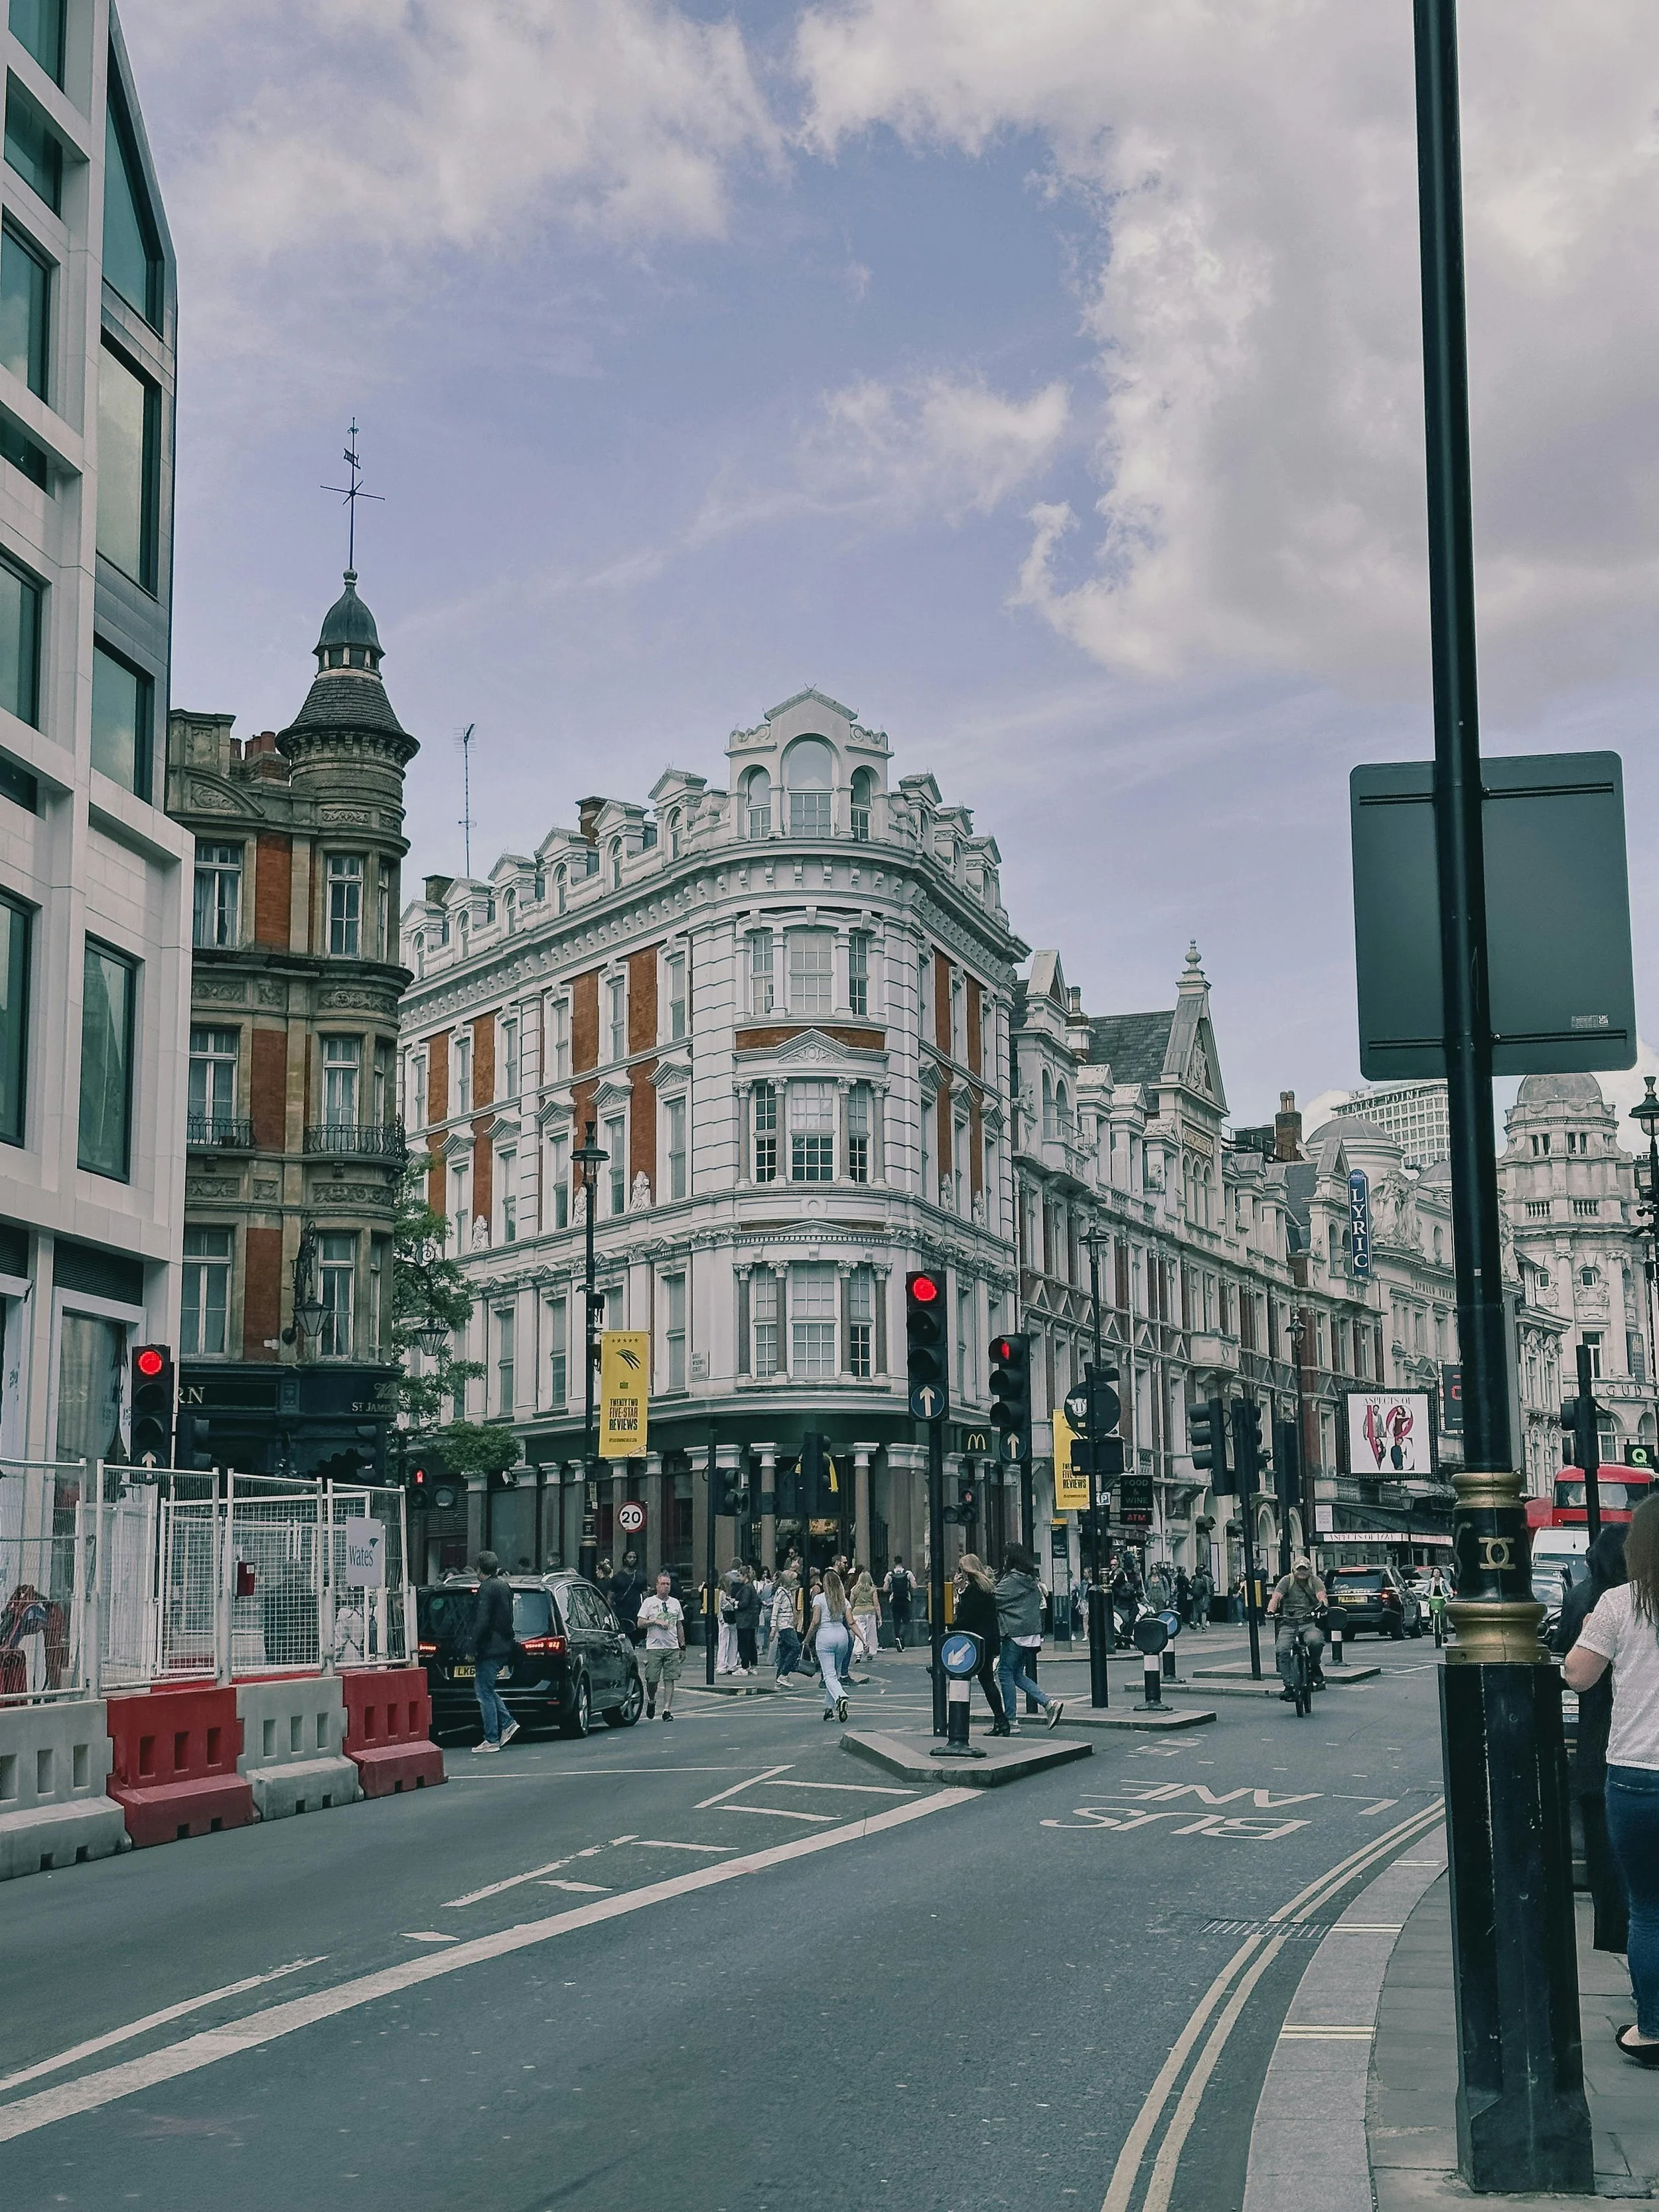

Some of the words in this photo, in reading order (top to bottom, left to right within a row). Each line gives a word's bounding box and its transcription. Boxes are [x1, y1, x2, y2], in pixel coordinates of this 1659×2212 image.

[1385, 1089, 1421, 1104] POINT
[1351, 1188, 1368, 1268] LYRIC
[628, 1398, 638, 1407] TWO
[609, 1407, 638, 1418] FIVE-STAR
[609, 1418, 638, 1430] REVIEWS
[1063, 1480, 1086, 1489] REVIEWS
[622, 1511, 641, 1523] 20
[349, 1547, 373, 1566] Wates
[1080, 1779, 1400, 1816] LANE
[1039, 1806, 1313, 1841] BUS
